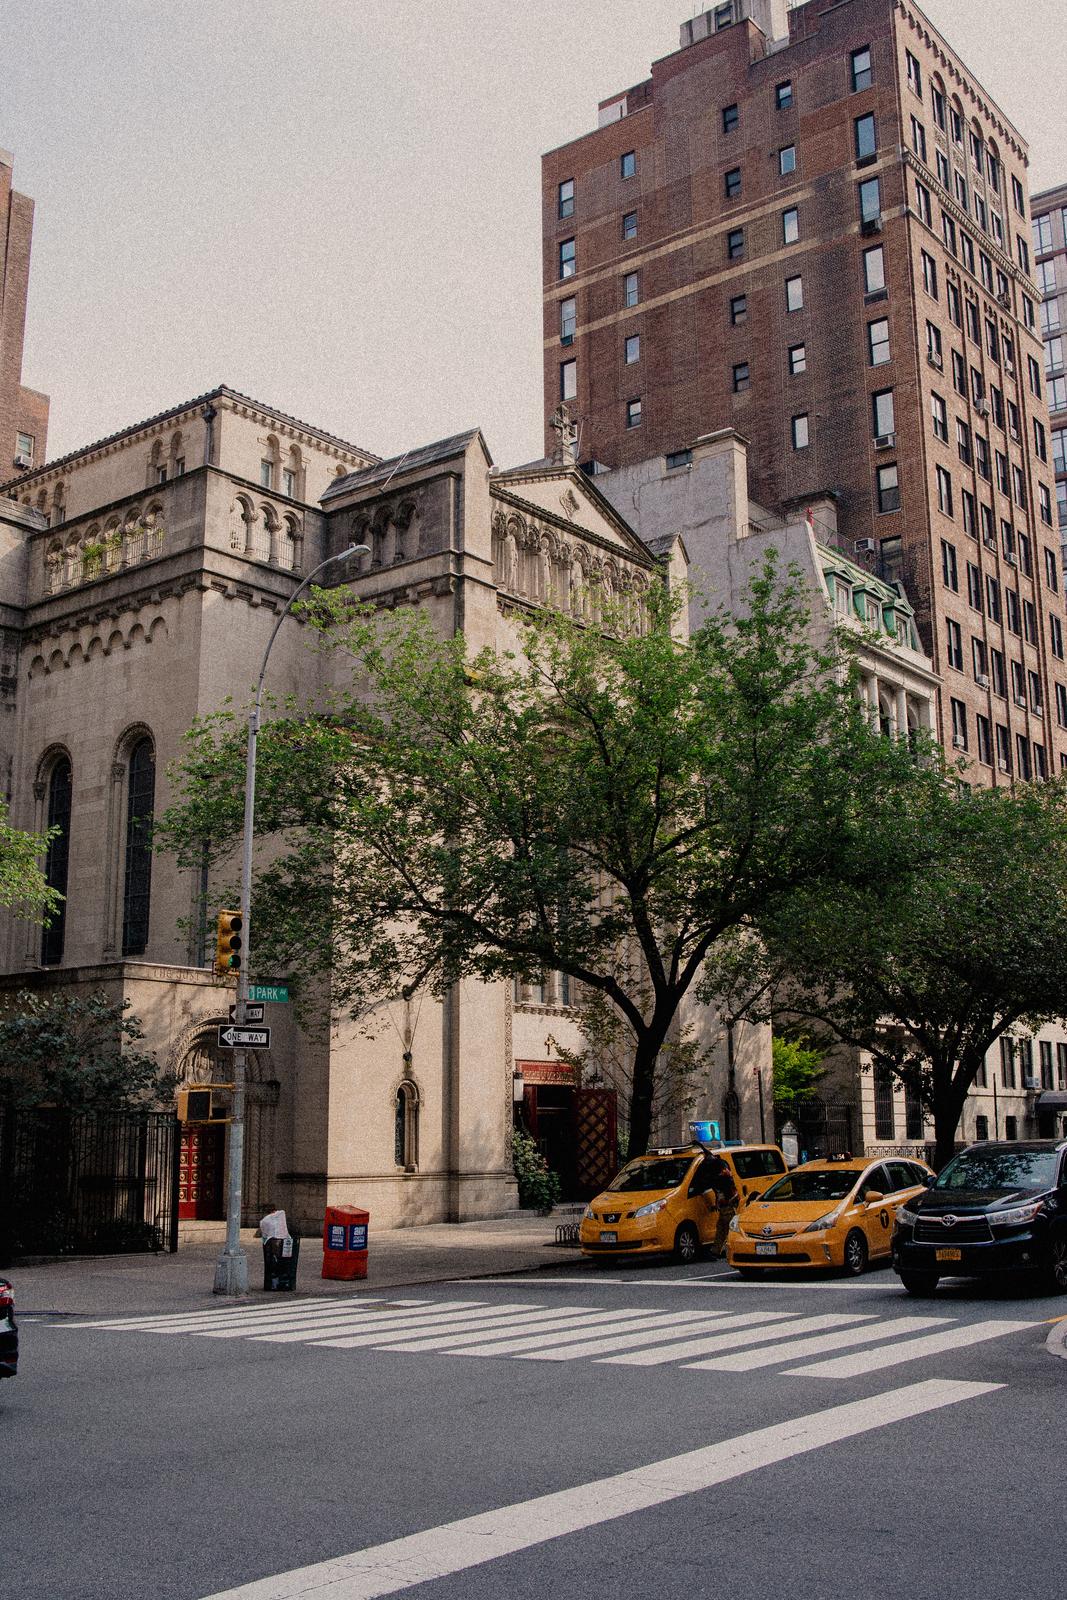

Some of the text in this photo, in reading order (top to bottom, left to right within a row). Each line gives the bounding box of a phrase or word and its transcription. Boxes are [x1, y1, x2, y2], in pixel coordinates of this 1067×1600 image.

[256, 987, 278, 1000] PARK
[226, 1032, 264, 1042] ONE WAY
